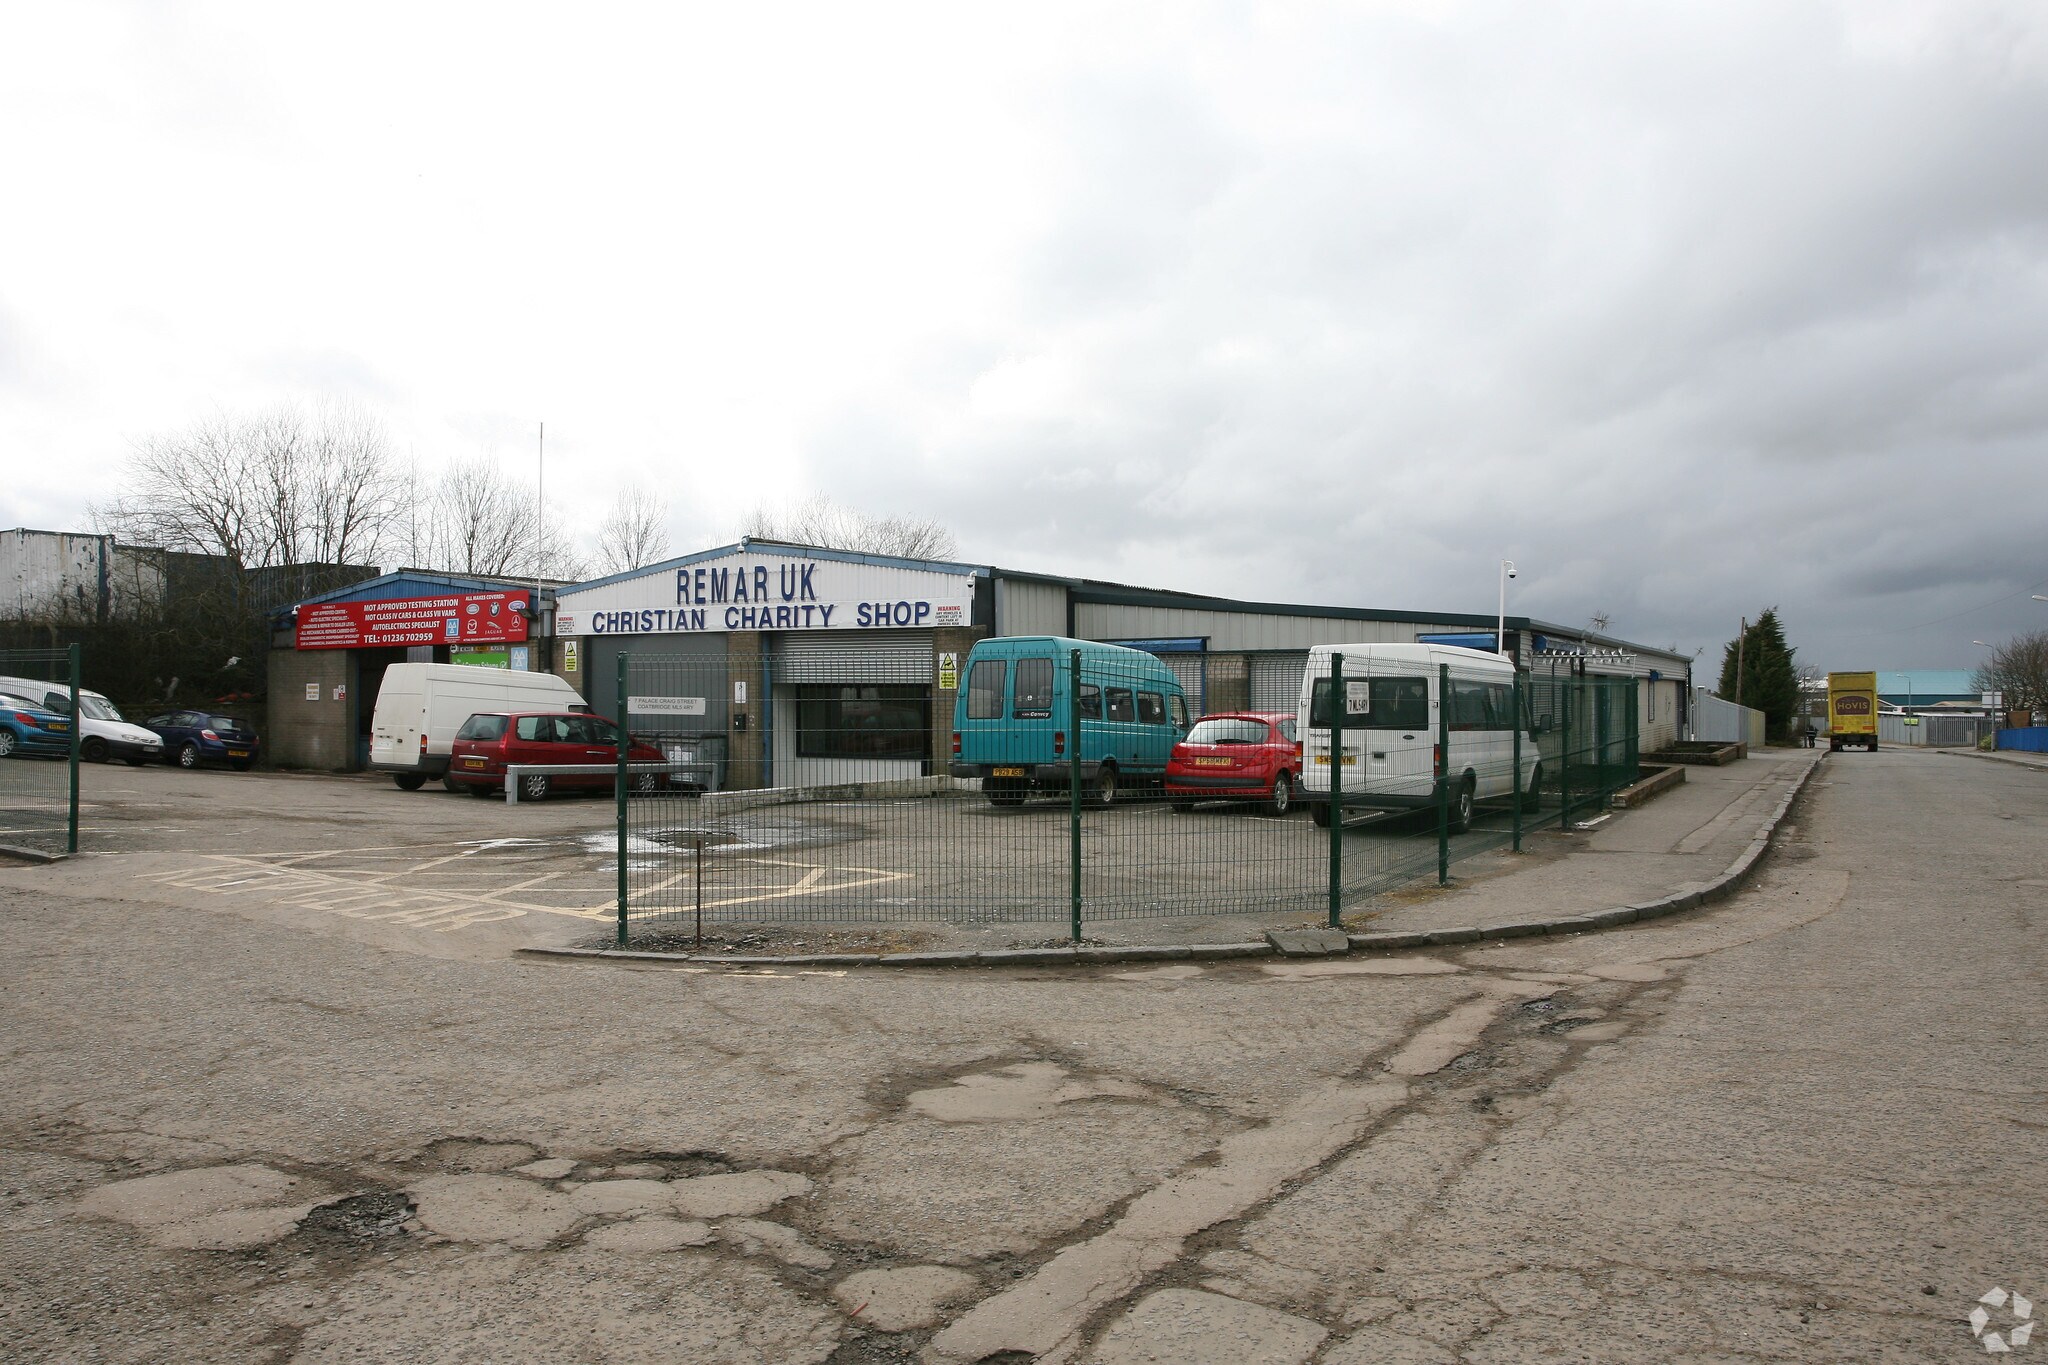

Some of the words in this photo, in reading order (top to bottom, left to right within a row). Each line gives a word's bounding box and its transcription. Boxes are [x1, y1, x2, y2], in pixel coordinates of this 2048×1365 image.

[677, 566, 768, 605] REMAR
[781, 563, 816, 601] UK
[377, 602, 407, 610] APPROVED
[408, 600, 433, 609] TESTING
[433, 599, 459, 607] STATION
[592, 608, 705, 633] CHRISTIAN
[724, 604, 834, 629] CHARITY
[856, 601, 930, 627] SHOP
[372, 622, 411, 630] AUTOELECTRICS
[411, 620, 440, 629] SPECIALIST
[364, 634, 380, 643] TEL:
[383, 634, 404, 642] 01236
[406, 633, 433, 641] 702959
